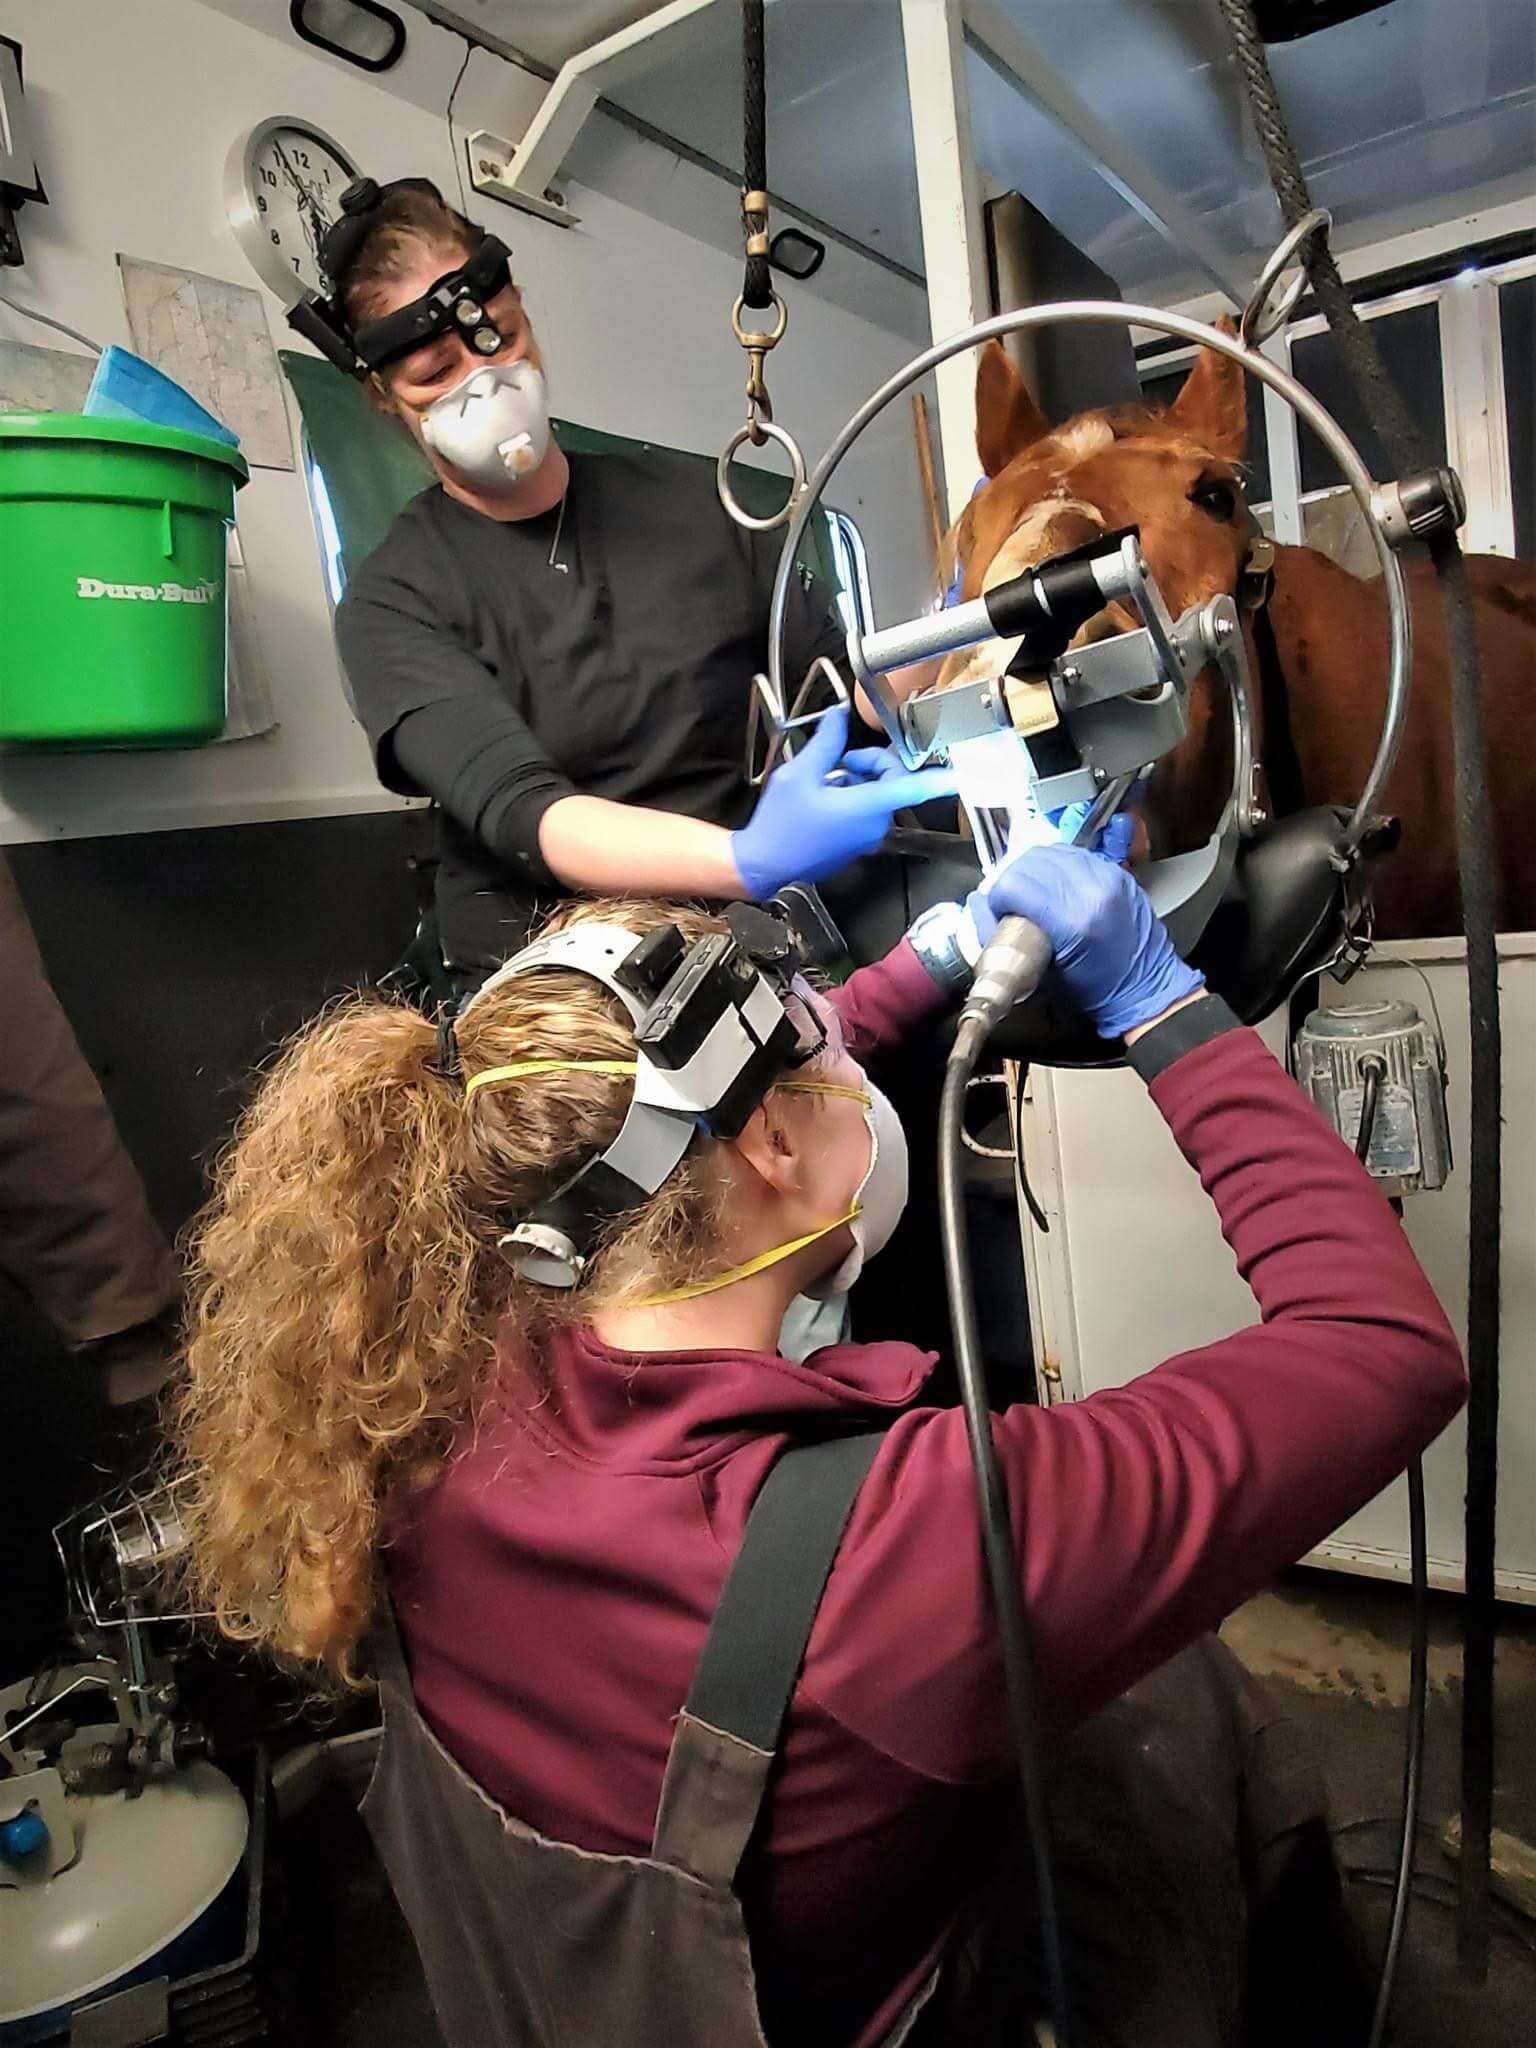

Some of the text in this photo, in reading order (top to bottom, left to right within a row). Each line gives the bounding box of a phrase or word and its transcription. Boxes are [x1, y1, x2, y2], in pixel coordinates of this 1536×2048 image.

[292, 150, 310, 169] 12
[259, 168, 277, 187] 10
[323, 169, 331, 184] 1
[257, 196, 267, 212] 9
[271, 230, 280, 245] 8
[291, 257, 300, 272] 7
[319, 274, 328, 289] 6
